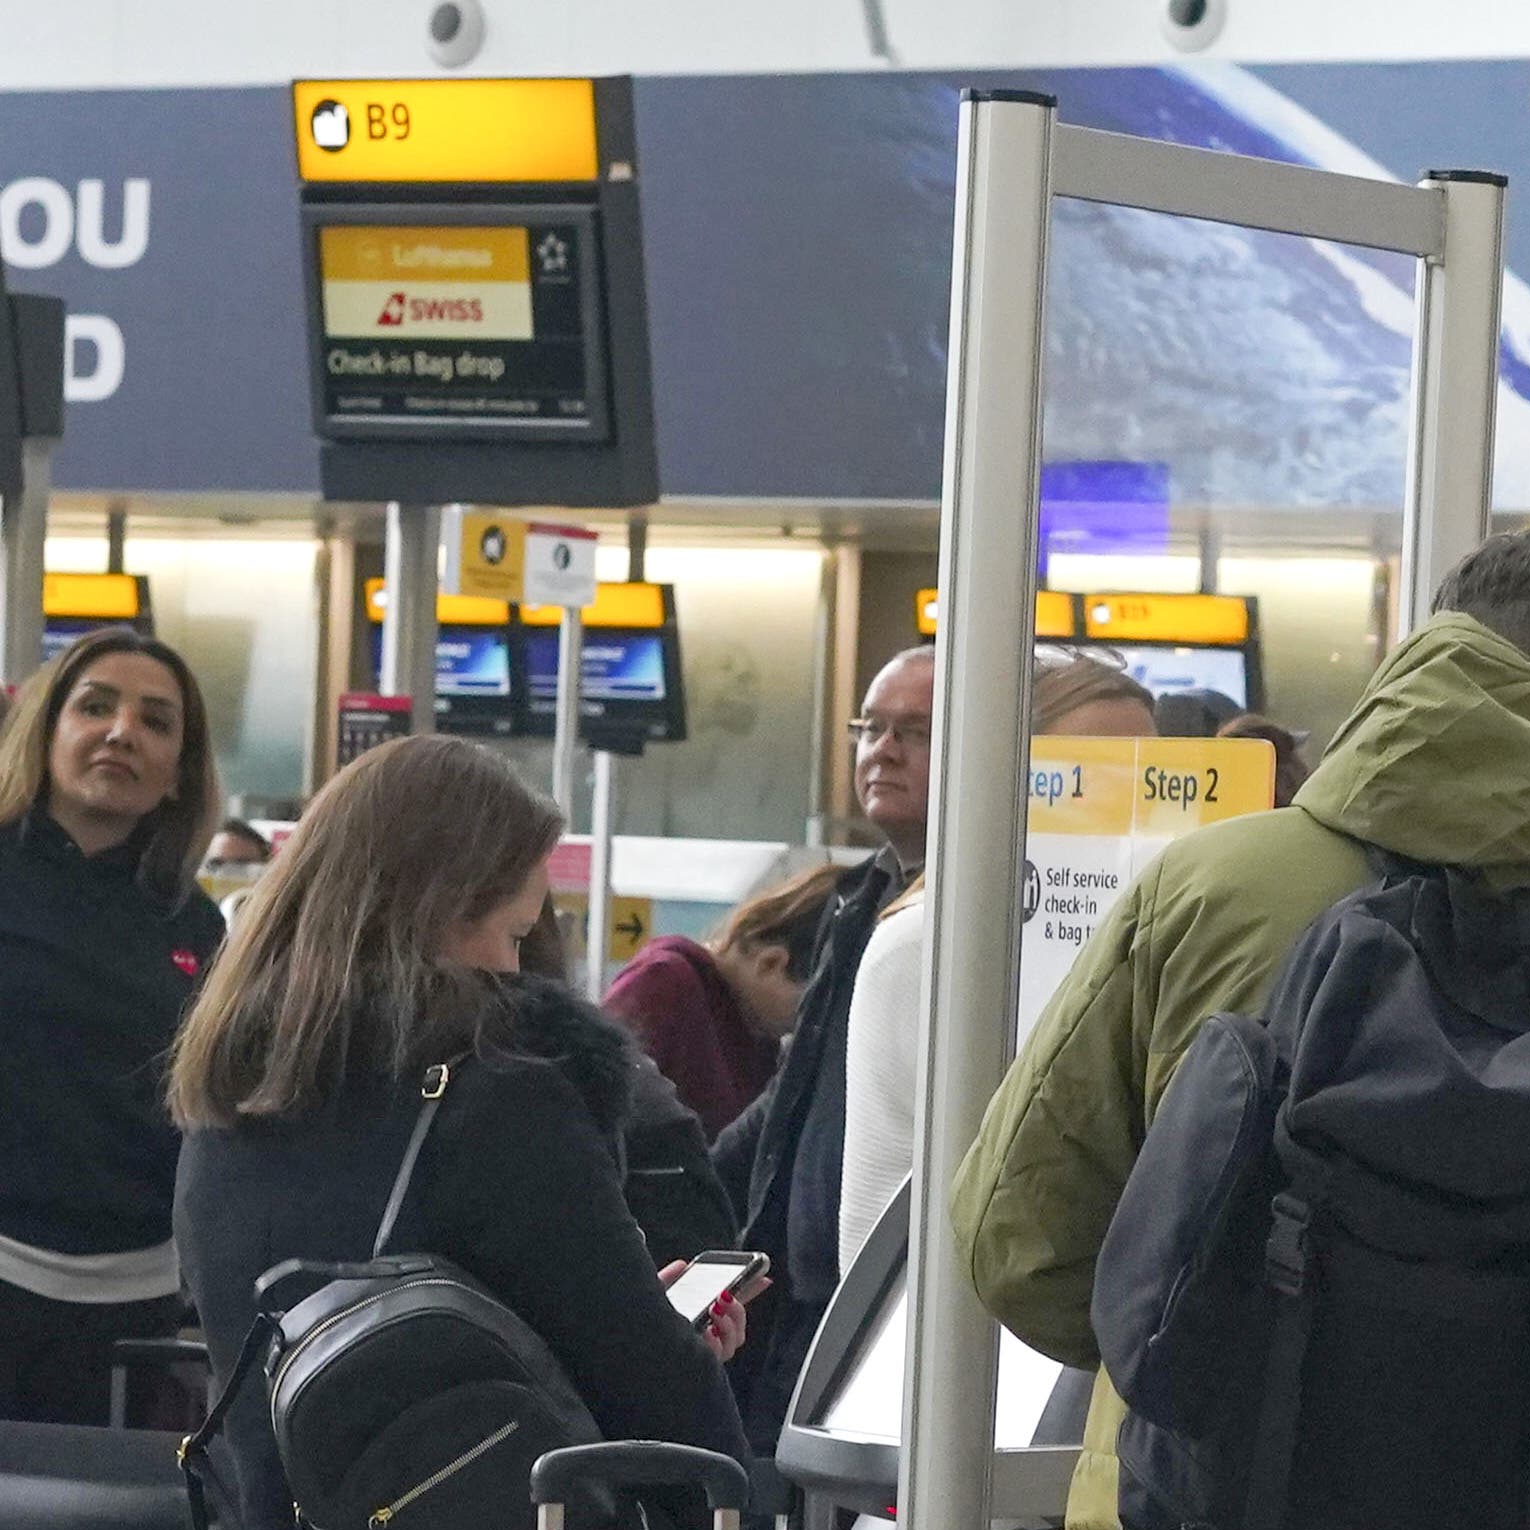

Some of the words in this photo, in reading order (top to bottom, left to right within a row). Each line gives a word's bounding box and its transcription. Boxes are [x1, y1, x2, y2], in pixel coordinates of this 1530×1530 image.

[366, 102, 411, 141] B9
[0, 176, 151, 269] OU
[411, 298, 484, 323] SWISS
[1072, 764, 1083, 798] 1
[1143, 765, 1198, 811] Step
[1204, 768, 1218, 803] 2
[1046, 867, 1070, 887] Self
[1073, 869, 1119, 890] service
[1044, 895, 1097, 915] check-in
[1044, 920, 1054, 940] &
[1058, 920, 1082, 946] bag
